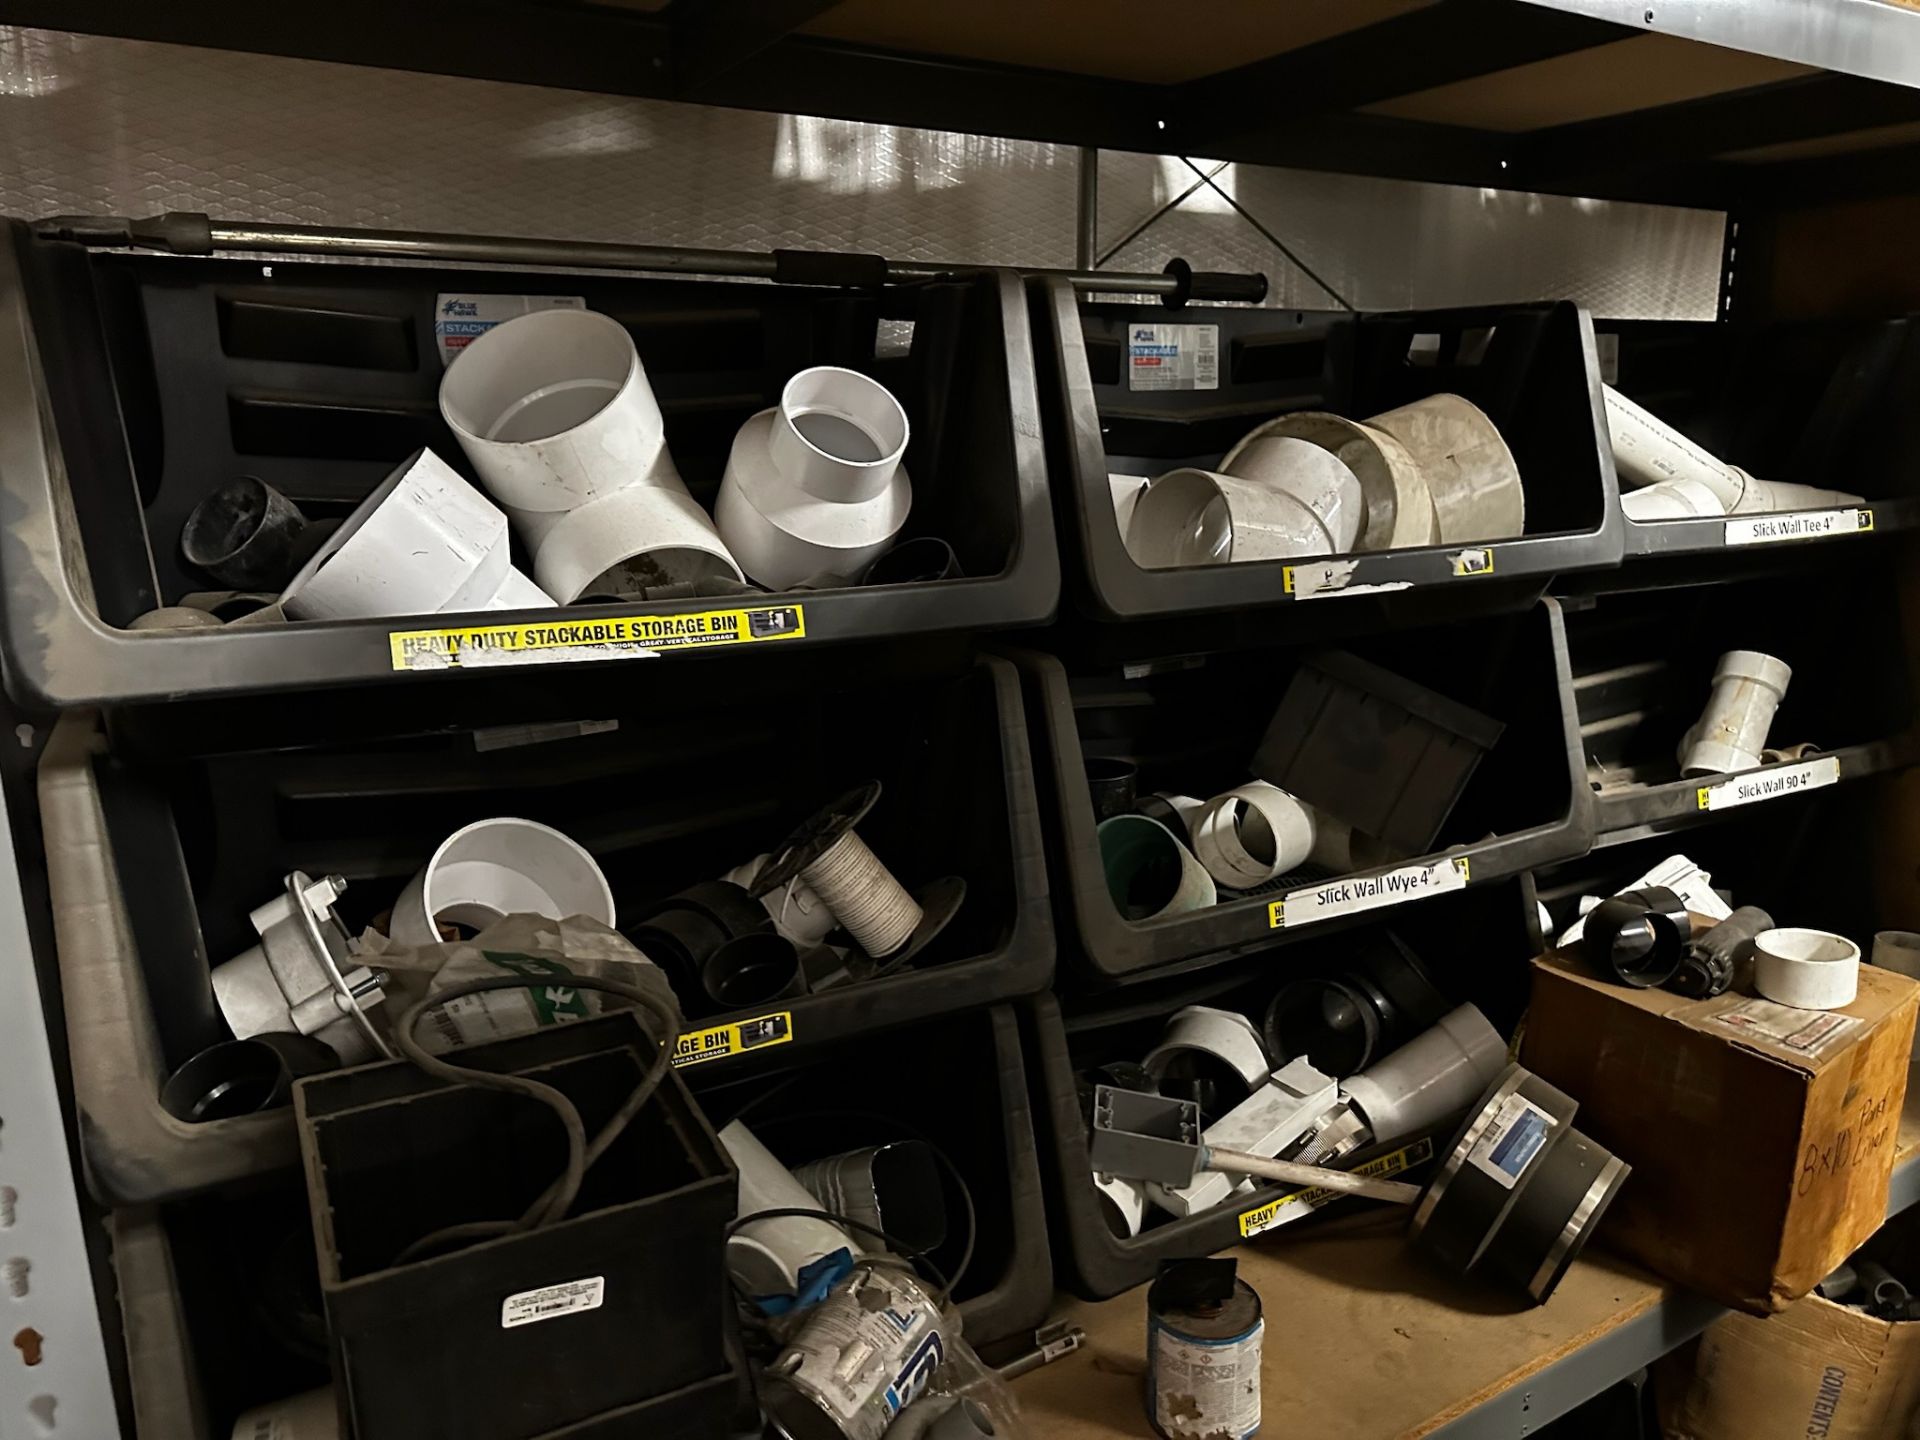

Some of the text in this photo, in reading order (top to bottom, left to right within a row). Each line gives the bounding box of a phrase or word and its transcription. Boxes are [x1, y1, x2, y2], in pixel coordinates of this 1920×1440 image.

[1753, 523, 1776, 538] Slick
[1778, 519, 1801, 535] Wall
[1803, 518, 1822, 532] Tee
[402, 615, 738, 655] HEAVY DUTY STACKABLE STORAGE BIN
[1738, 783, 1762, 799] Slick
[1762, 778, 1784, 794] Wall
[1786, 775, 1798, 789] 90
[1317, 885, 1350, 906] Slick
[1353, 878, 1383, 899] Wall
[1386, 874, 1417, 893] Wye
[704, 1031, 729, 1048] BIN
[1245, 1206, 1274, 1228] HEAVY
